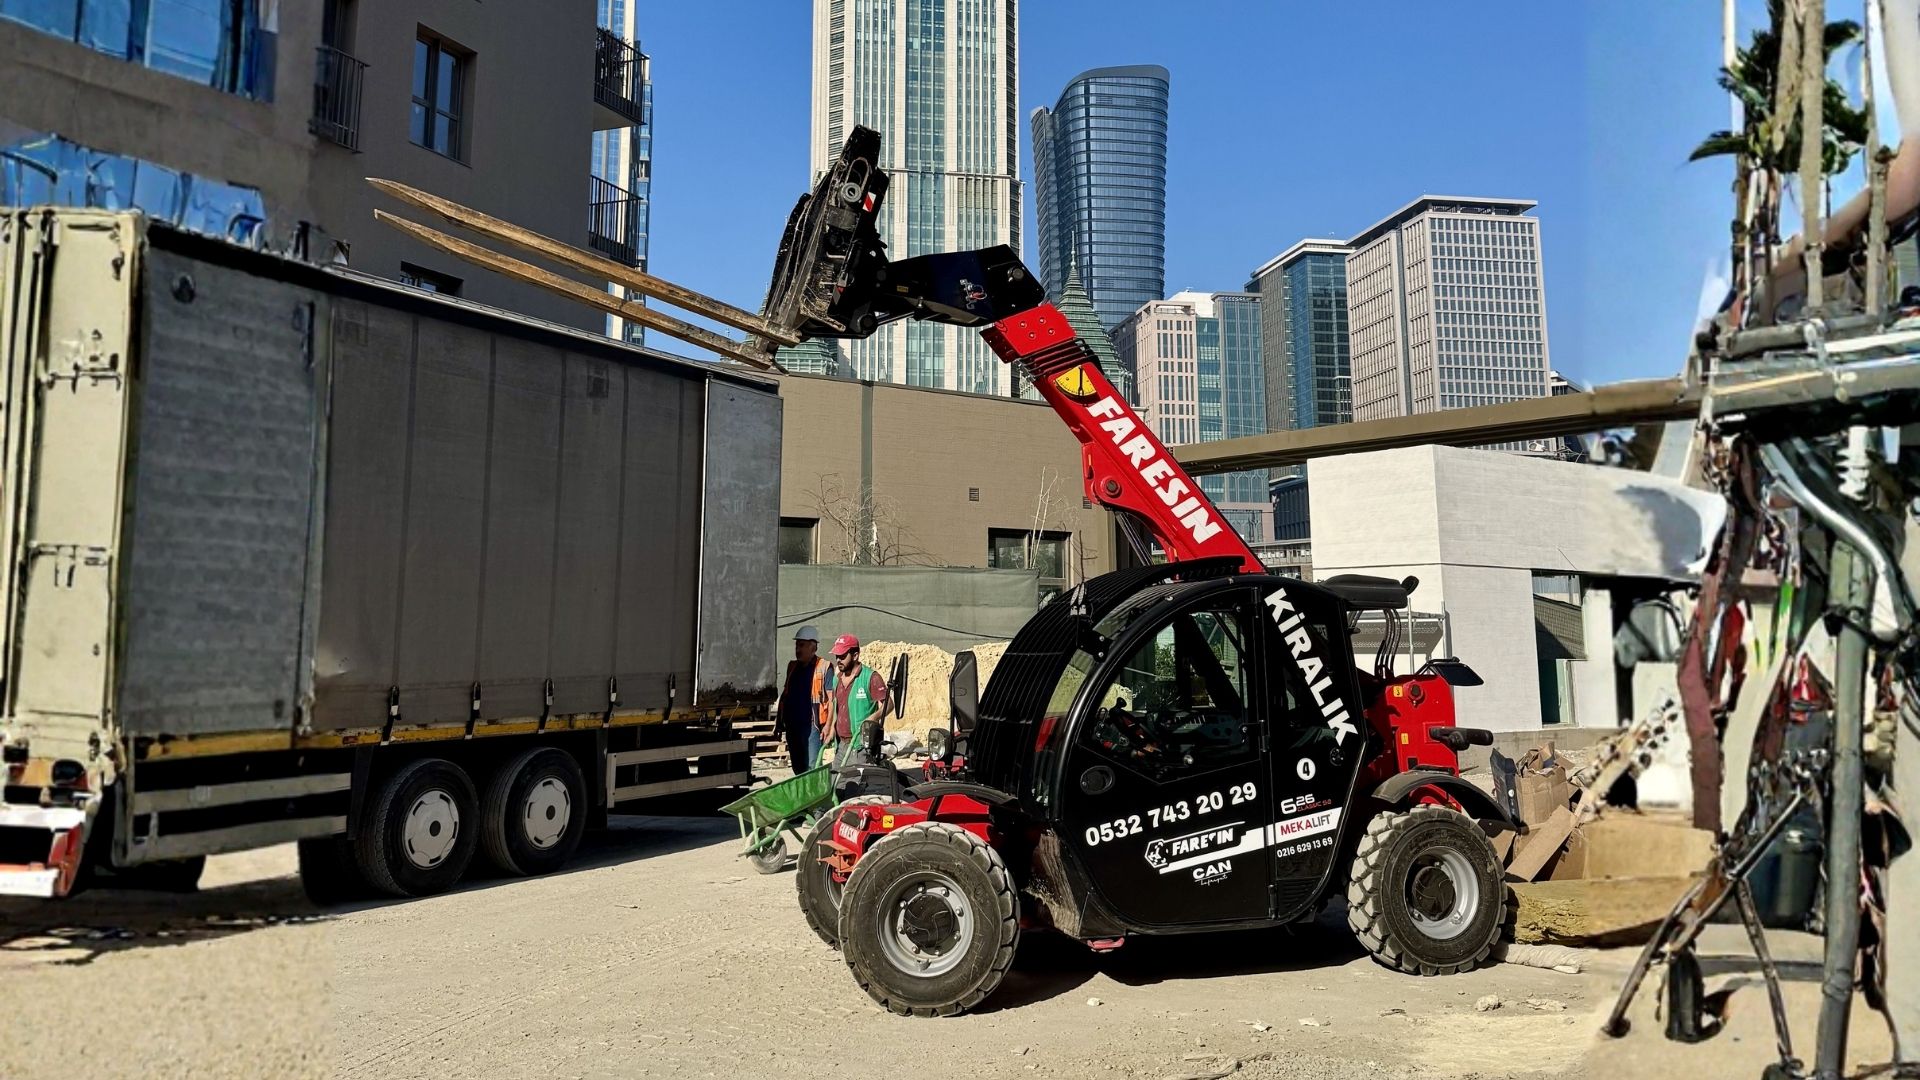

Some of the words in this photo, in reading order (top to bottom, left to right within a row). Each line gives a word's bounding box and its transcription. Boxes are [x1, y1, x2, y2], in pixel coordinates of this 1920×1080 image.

[1086, 396, 1223, 544] FARESIN
[1264, 588, 1359, 747] KİRALIK
[1302, 761, 1311, 777] 4
[1085, 815, 1143, 847] 0532
[1147, 800, 1191, 828] 743
[1196, 791, 1224, 815] 20
[1229, 782, 1257, 806] 29
[1280, 793, 1315, 815] 626
[1280, 814, 1331, 836] MEKALIFT
[1276, 846, 1296, 858] 0216
[1296, 842, 1312, 853] 629
[1312, 839, 1321, 849] 13
[1322, 836, 1333, 847] 69
[1192, 859, 1232, 880] CAN
